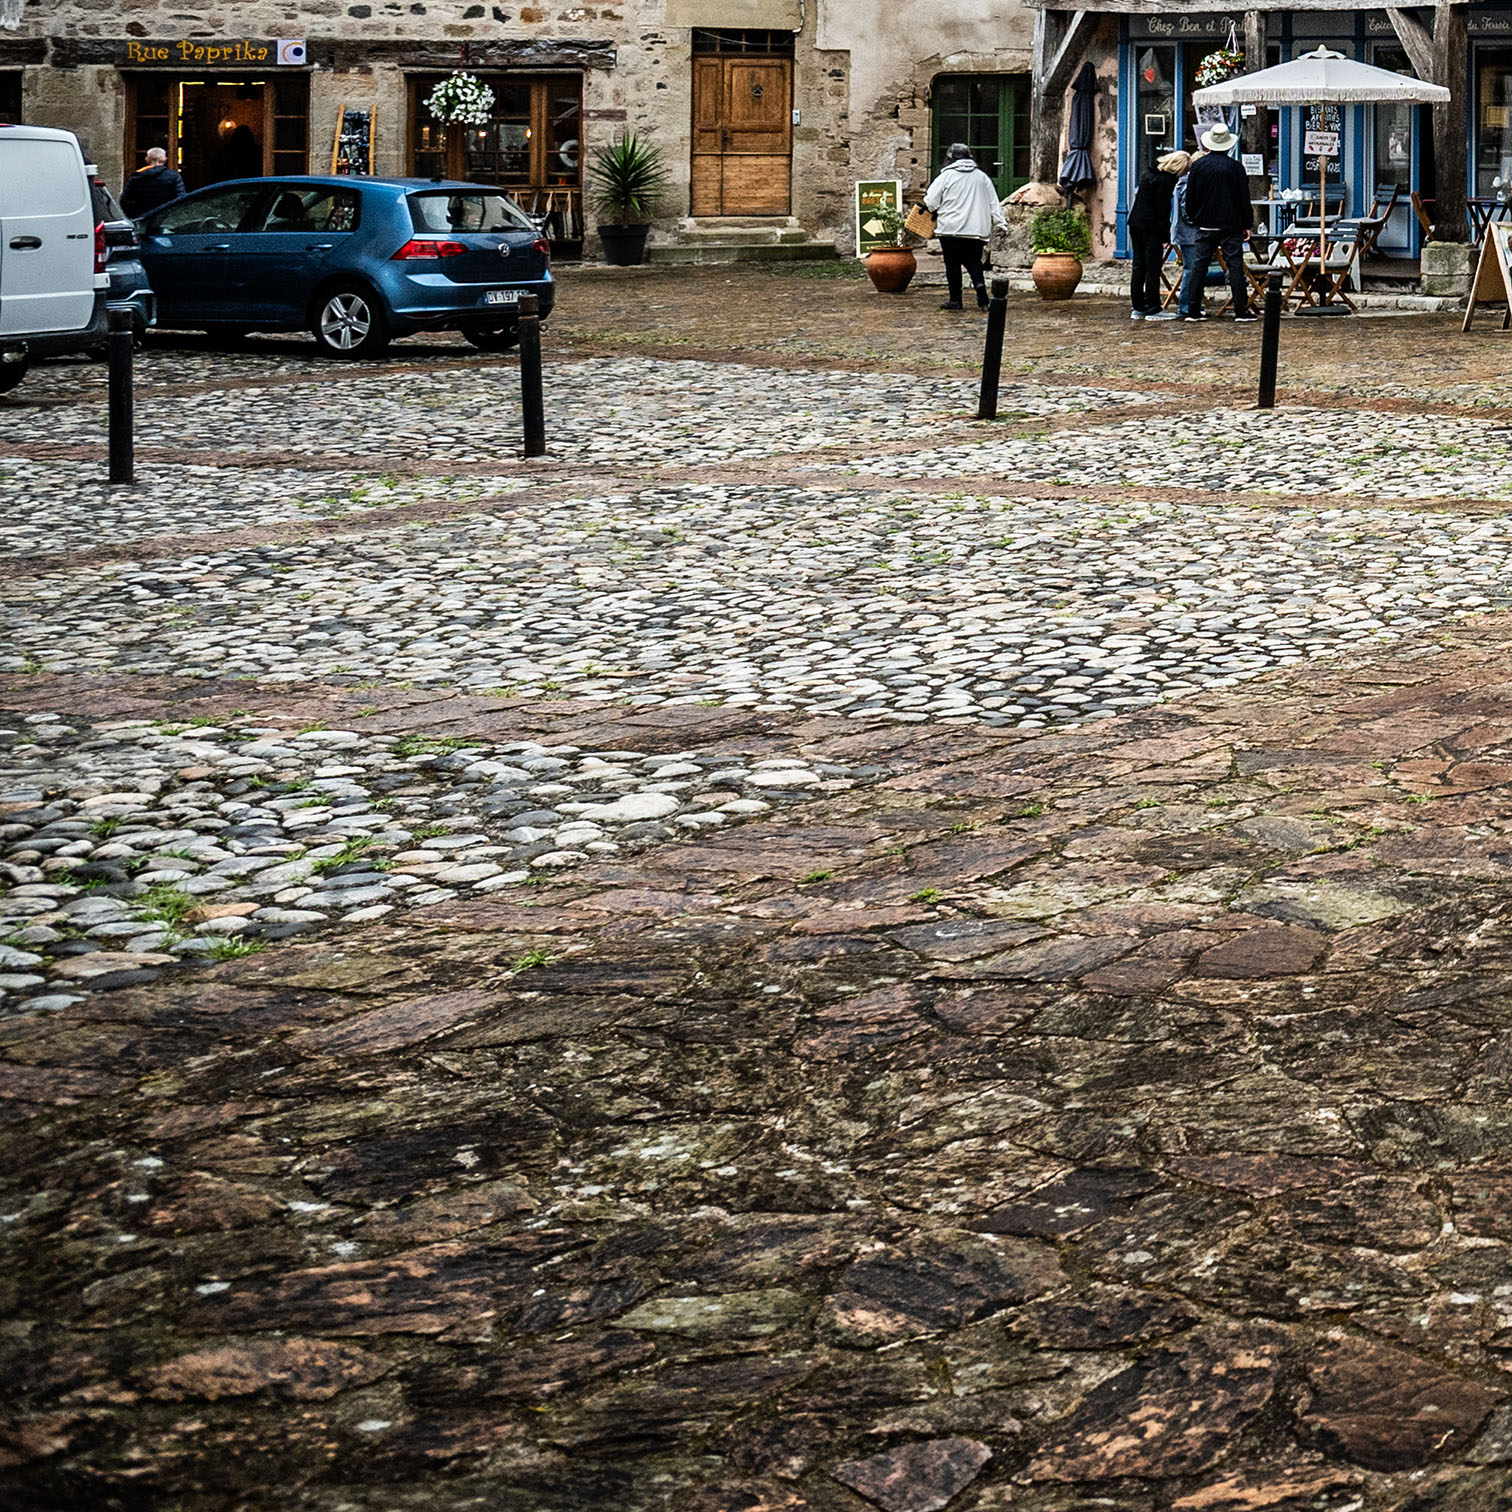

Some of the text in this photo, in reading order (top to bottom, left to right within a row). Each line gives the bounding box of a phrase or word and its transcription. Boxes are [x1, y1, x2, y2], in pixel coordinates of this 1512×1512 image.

[1147, 16, 1175, 35] Chez
[1180, 16, 1202, 32] Ben
[1206, 19, 1216, 31] et
[127, 40, 268, 65] Rue Paprika
